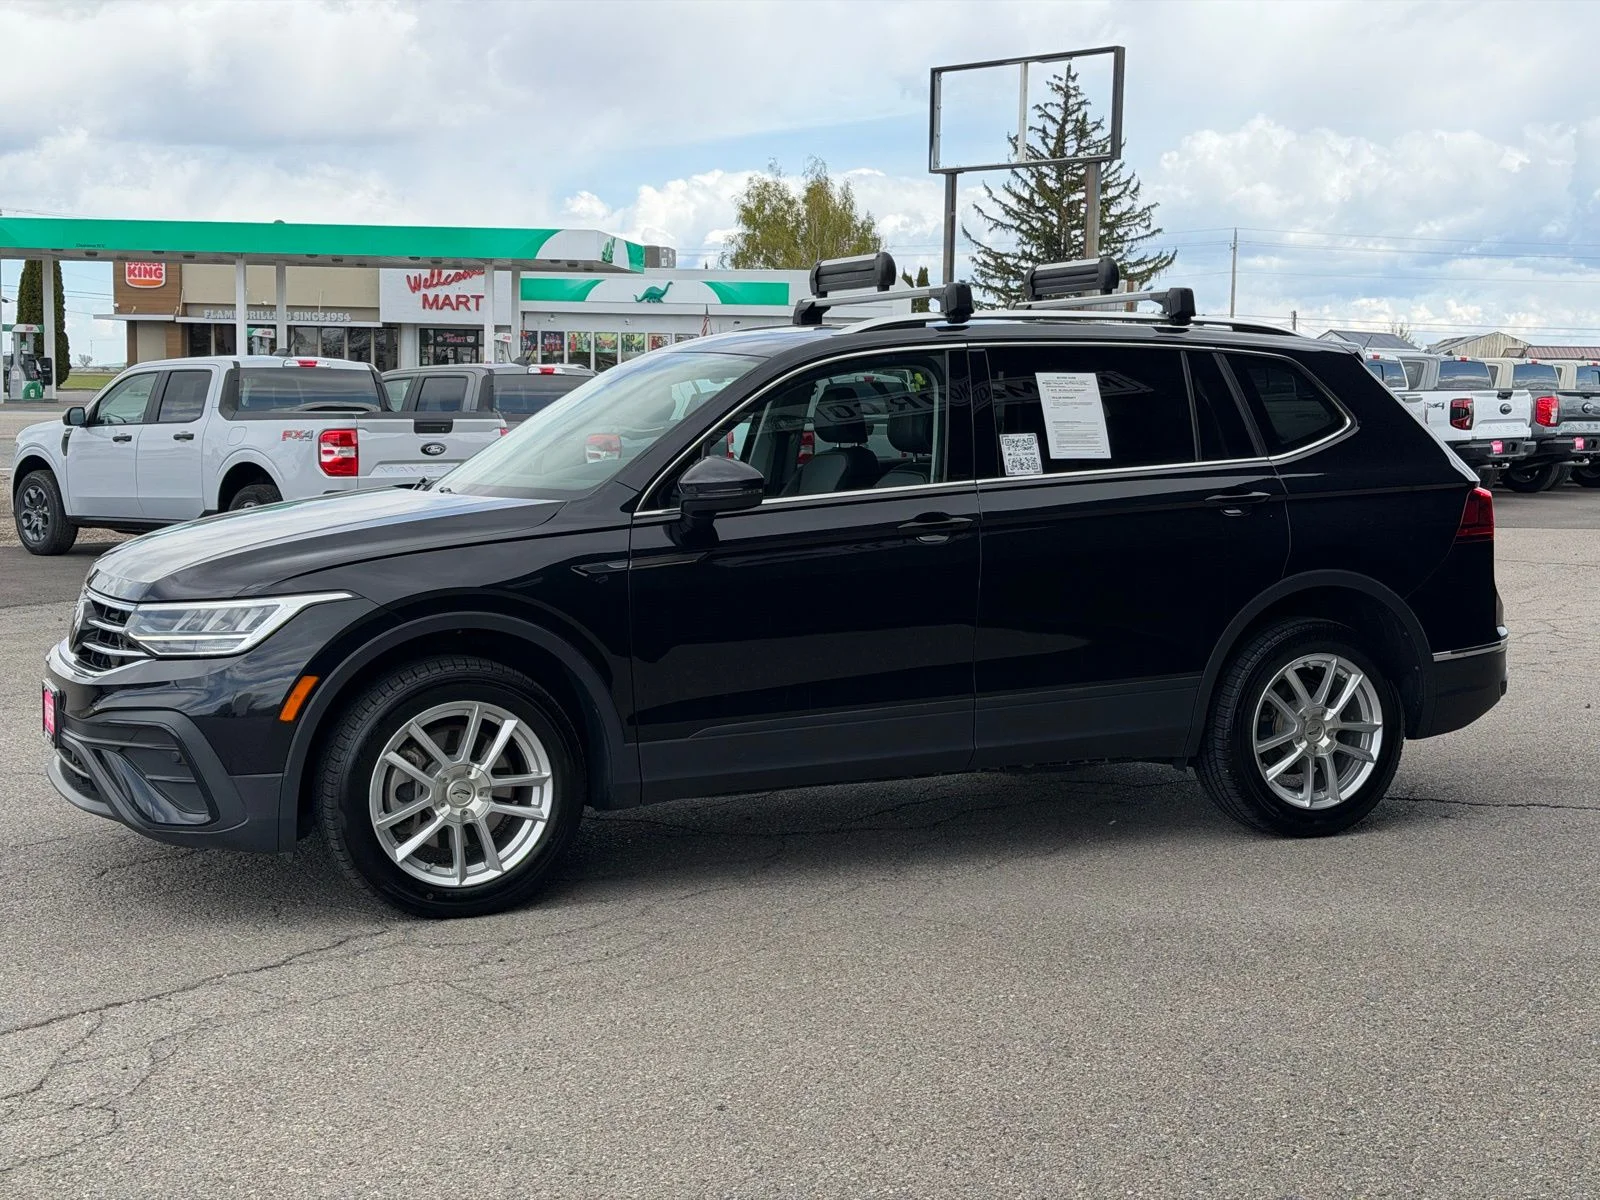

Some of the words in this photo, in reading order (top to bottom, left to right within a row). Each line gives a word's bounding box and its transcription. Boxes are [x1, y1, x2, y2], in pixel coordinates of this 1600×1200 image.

[127, 266, 164, 279] KING
[422, 293, 485, 312] MART
[293, 311, 325, 321] SINCE
[281, 429, 314, 442] FX4
